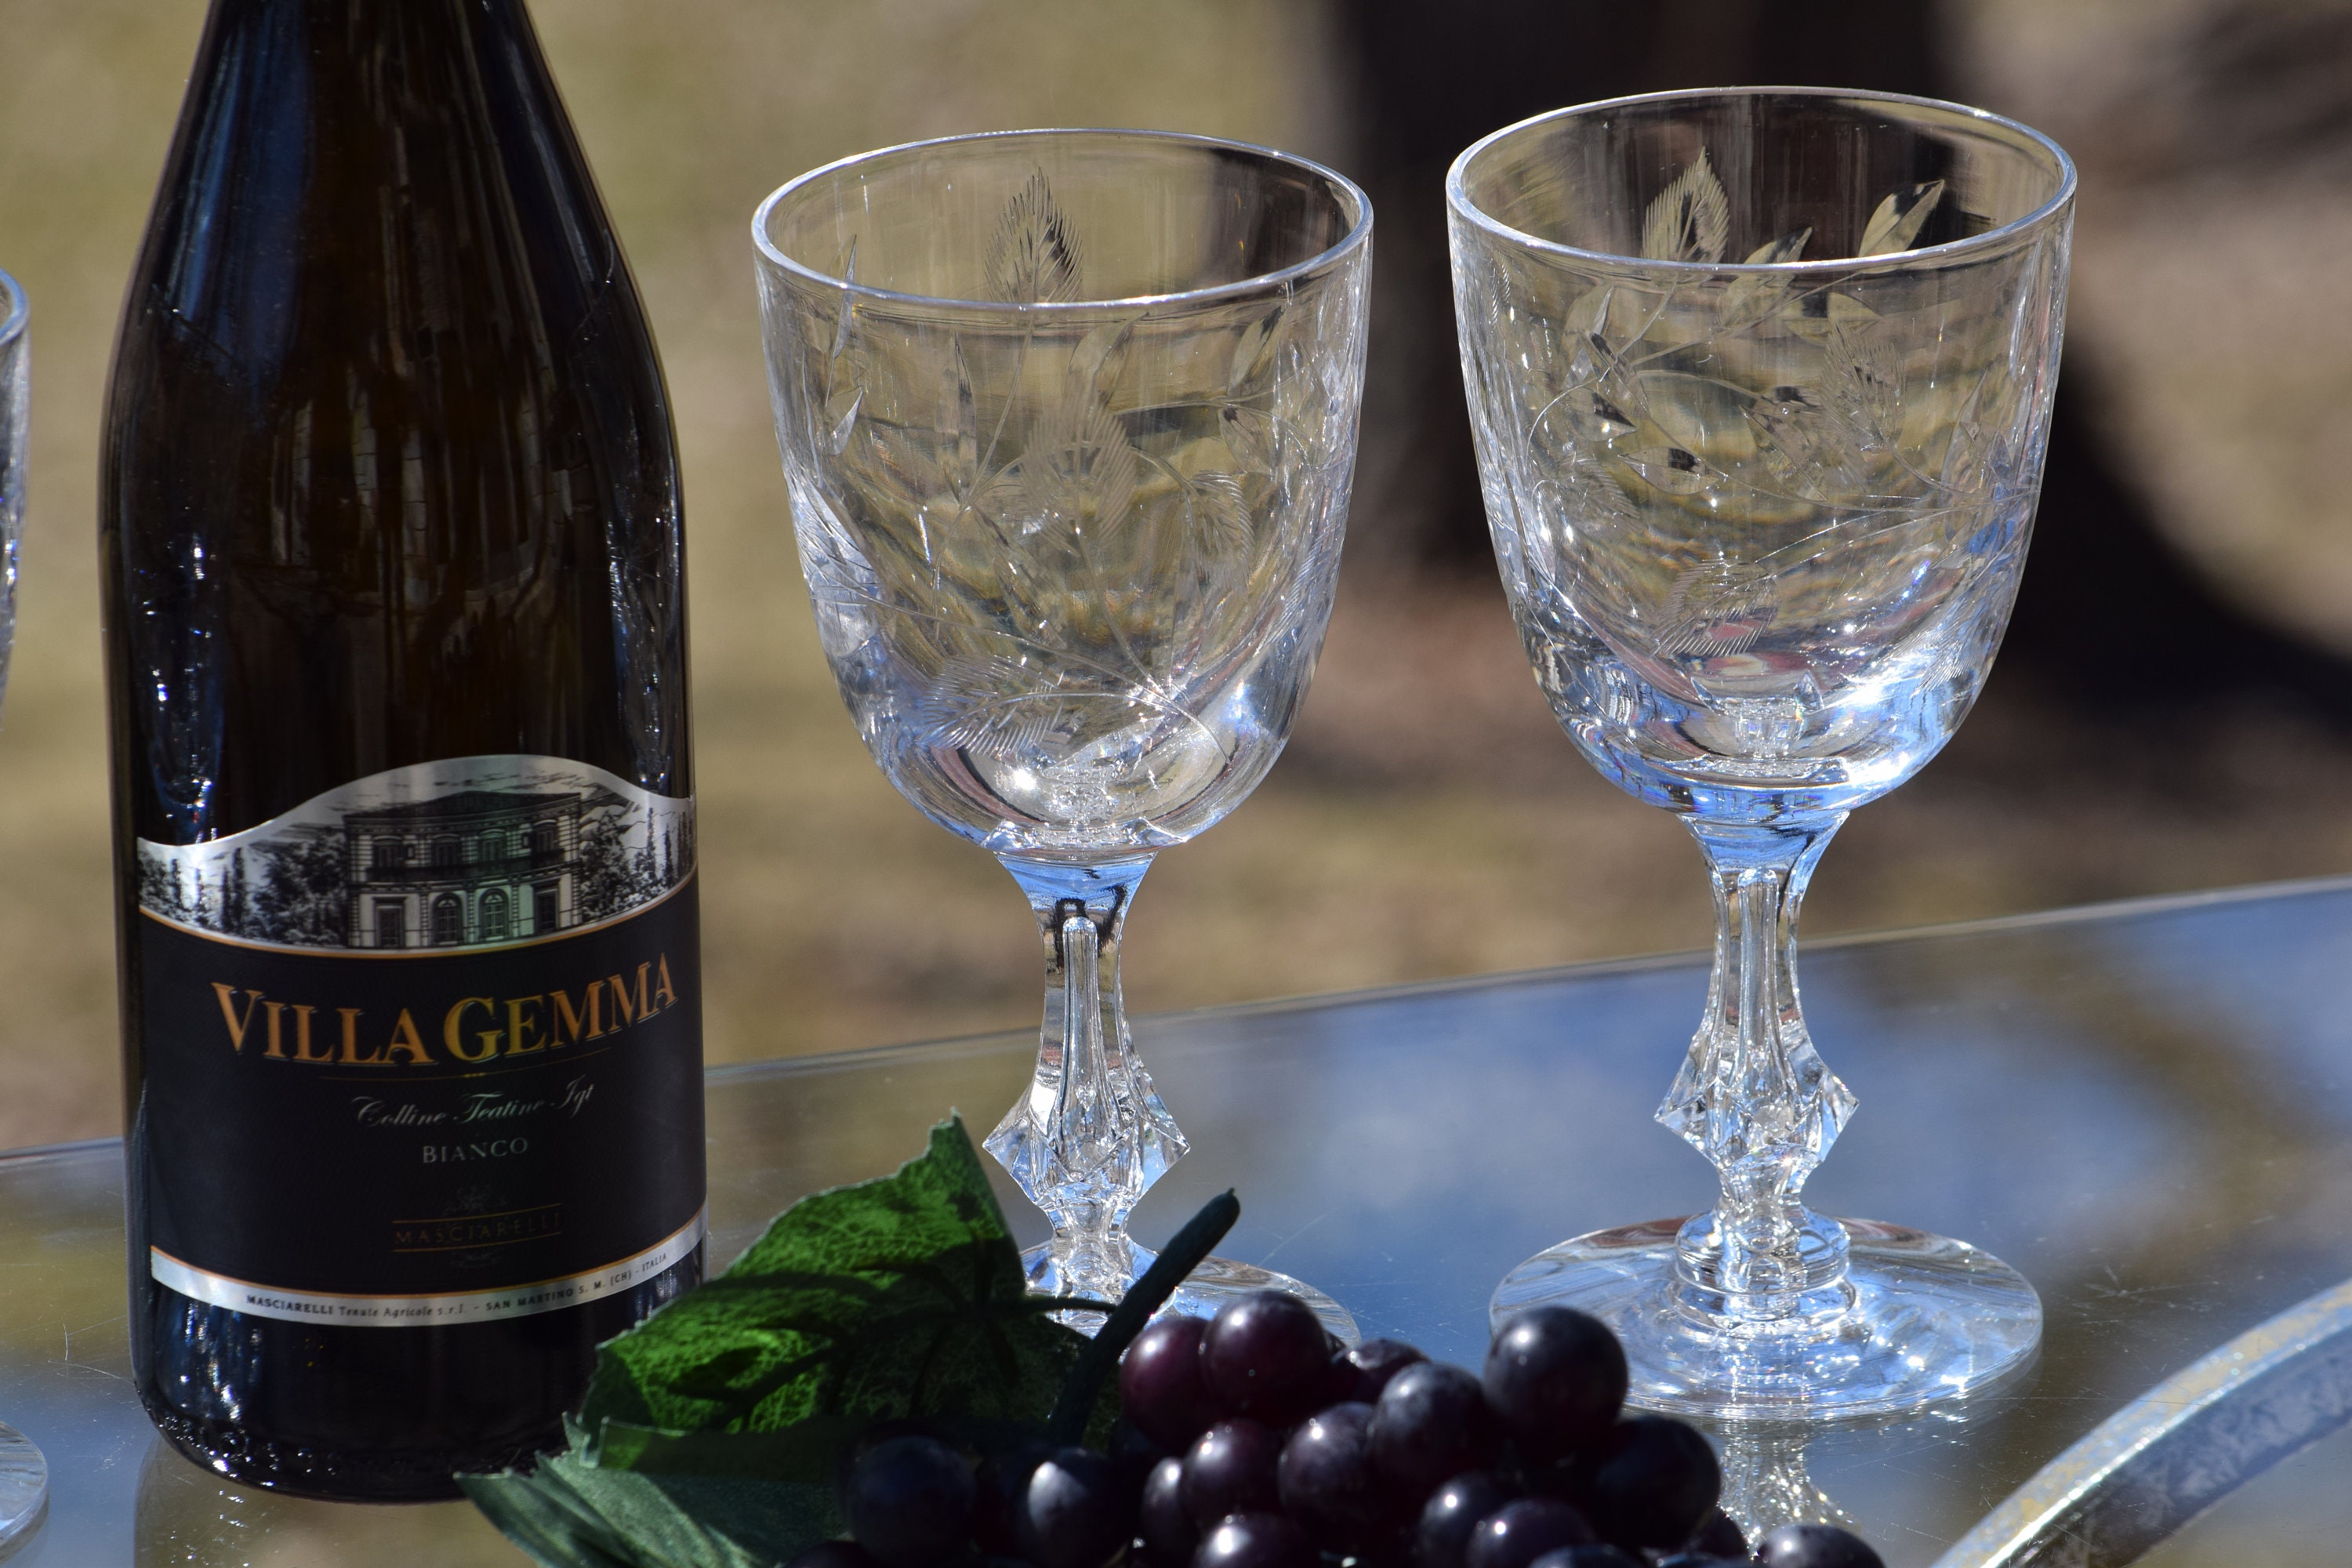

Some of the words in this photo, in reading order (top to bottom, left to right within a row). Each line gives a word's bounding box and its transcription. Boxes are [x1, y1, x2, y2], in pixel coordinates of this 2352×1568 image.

[211, 982, 437, 1065] VILLA
[444, 953, 678, 1063] GEMMA
[352, 1096, 448, 1127] Colline
[453, 1091, 545, 1123] Teatine
[423, 1138, 528, 1163] BIANCO
[394, 1212, 560, 1244] MASCIARELLI
[246, 1295, 333, 1315] MASCIARELLI
[337, 1305, 378, 1317] Tenute
[383, 1306, 432, 1318] Agricole
[486, 1299, 510, 1311] SAN
[517, 1287, 574, 1307] MARTINO
[593, 1279, 606, 1290] M.
[610, 1269, 632, 1287] (CH)
[642, 1253, 667, 1272] ITALIA
